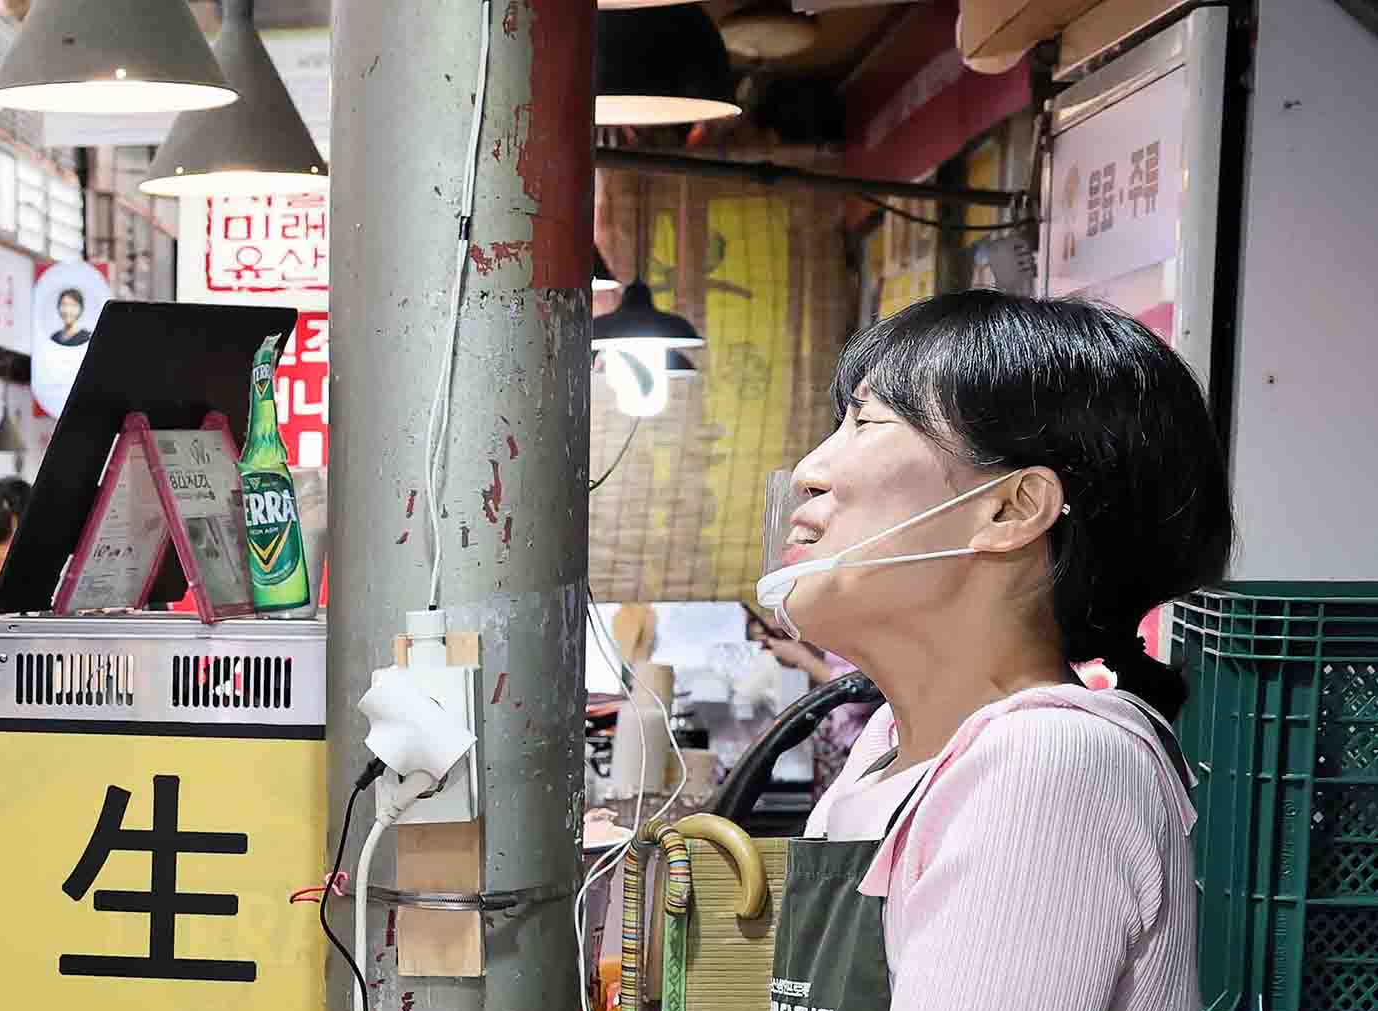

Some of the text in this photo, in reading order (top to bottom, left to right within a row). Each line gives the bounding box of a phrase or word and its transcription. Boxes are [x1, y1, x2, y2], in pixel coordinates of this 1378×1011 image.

[223, 211, 325, 240] 미래
[223, 246, 327, 281] 유산
[59, 775, 257, 982] 生
